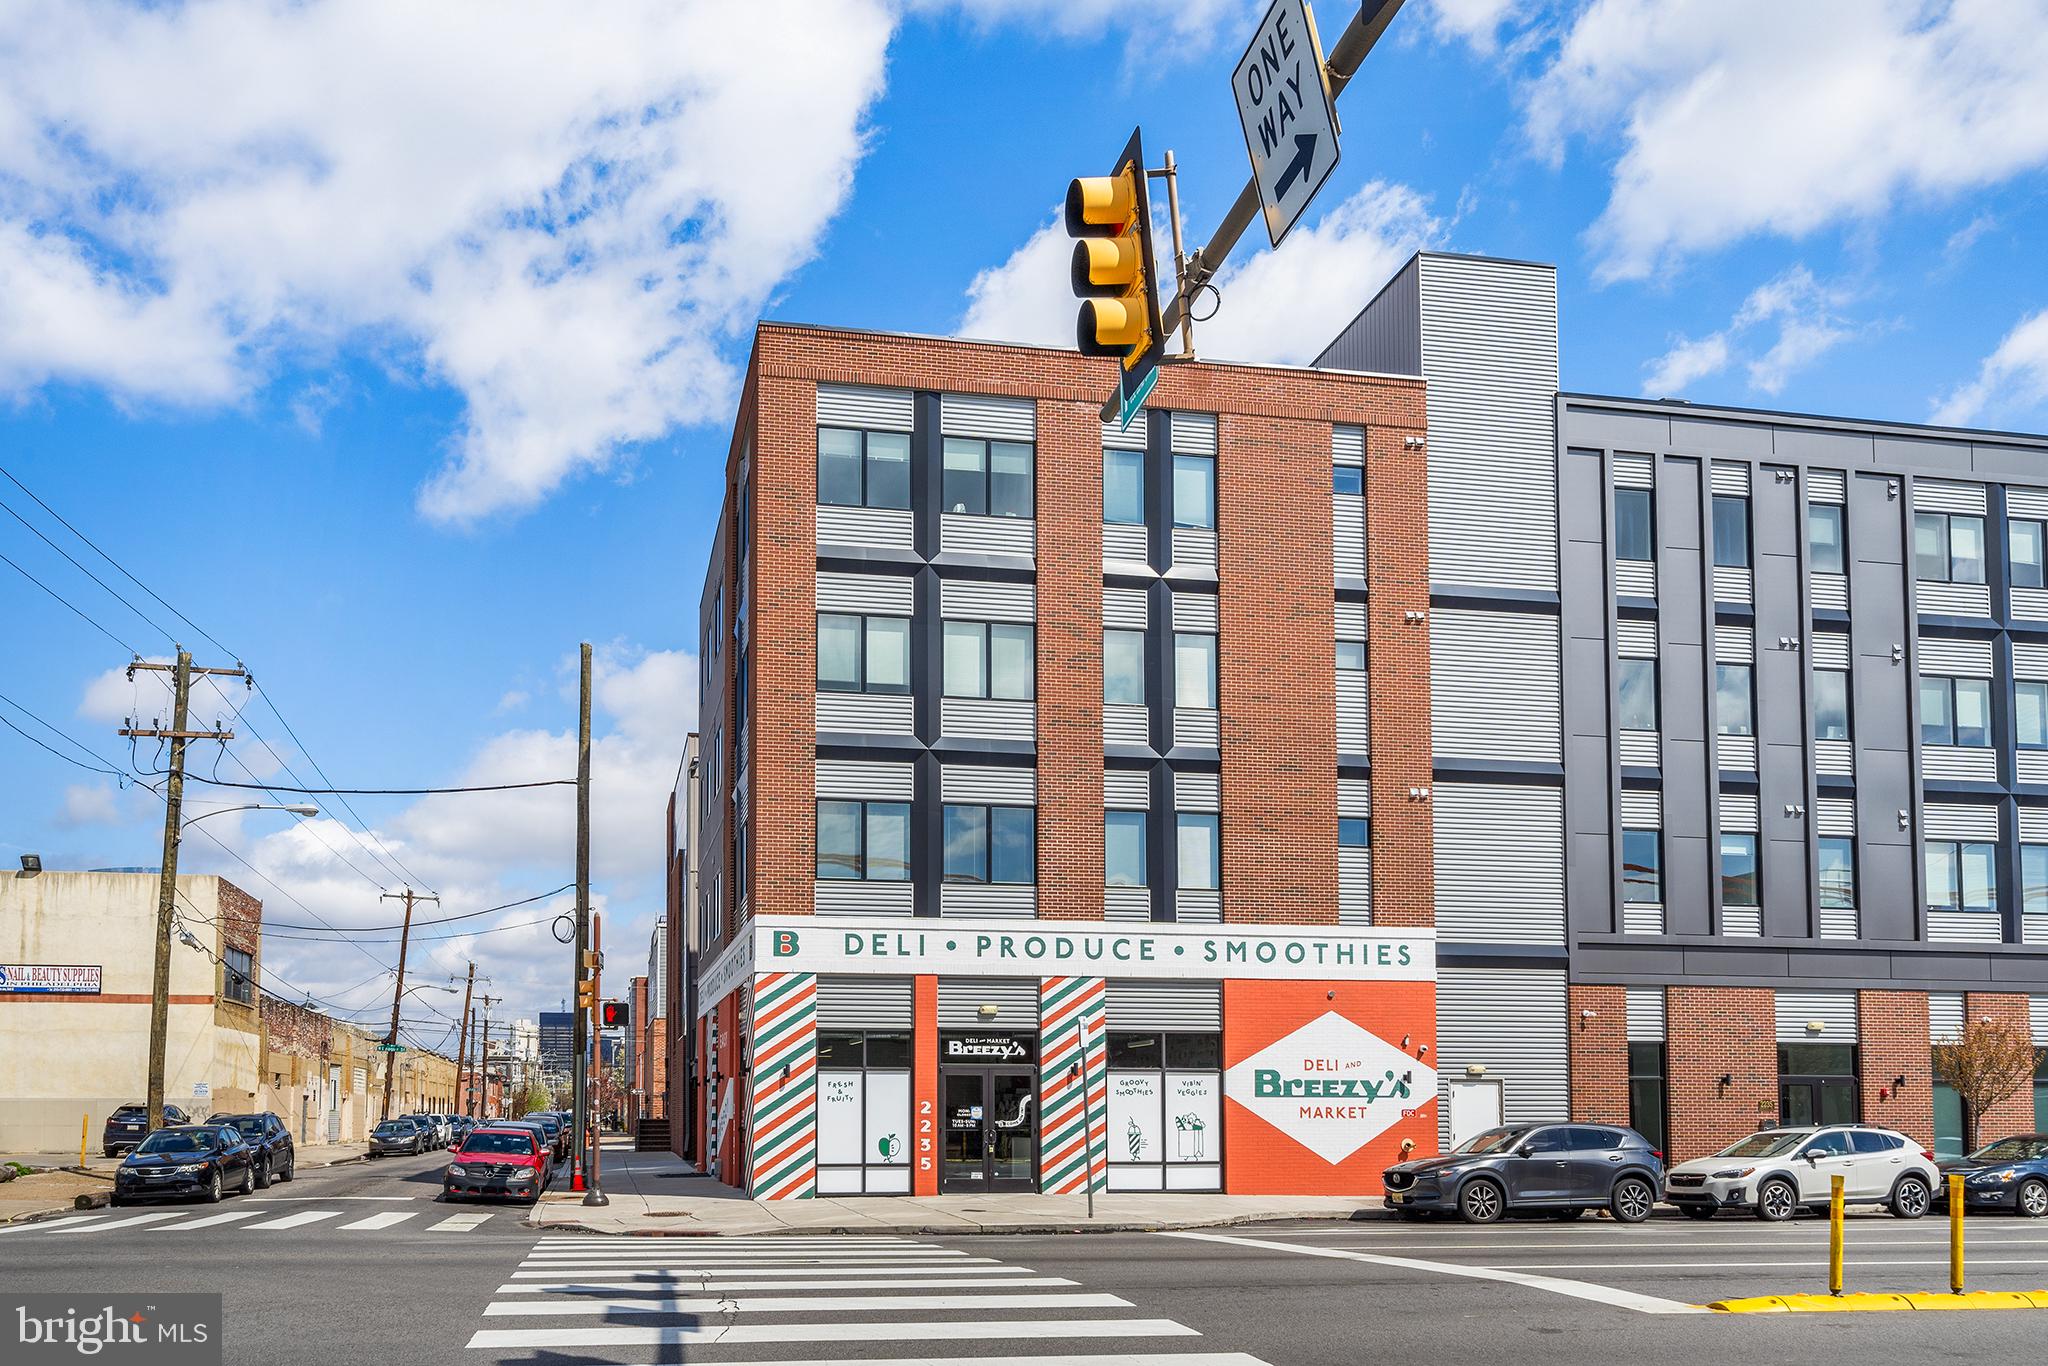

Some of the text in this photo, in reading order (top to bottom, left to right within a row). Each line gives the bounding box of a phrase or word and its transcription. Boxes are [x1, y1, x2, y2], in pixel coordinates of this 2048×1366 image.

[1249, 9, 1295, 106] ONE
[1258, 60, 1303, 159] WAY
[773, 930, 1411, 966] B DELI PRODUCE SMOOTHIES
[7, 967, 25, 981] NAIL
[32, 967, 62, 982] BEAUTY
[63, 968, 99, 982] SUPPLIES
[1304, 1059, 1362, 1071] DELI AND
[827, 1094, 854, 1103] FRUITY
[1116, 1088, 1154, 1096] SMOOTHIES
[1177, 1089, 1207, 1097] VEGGIES
[1300, 1106, 1367, 1119] MARKET
